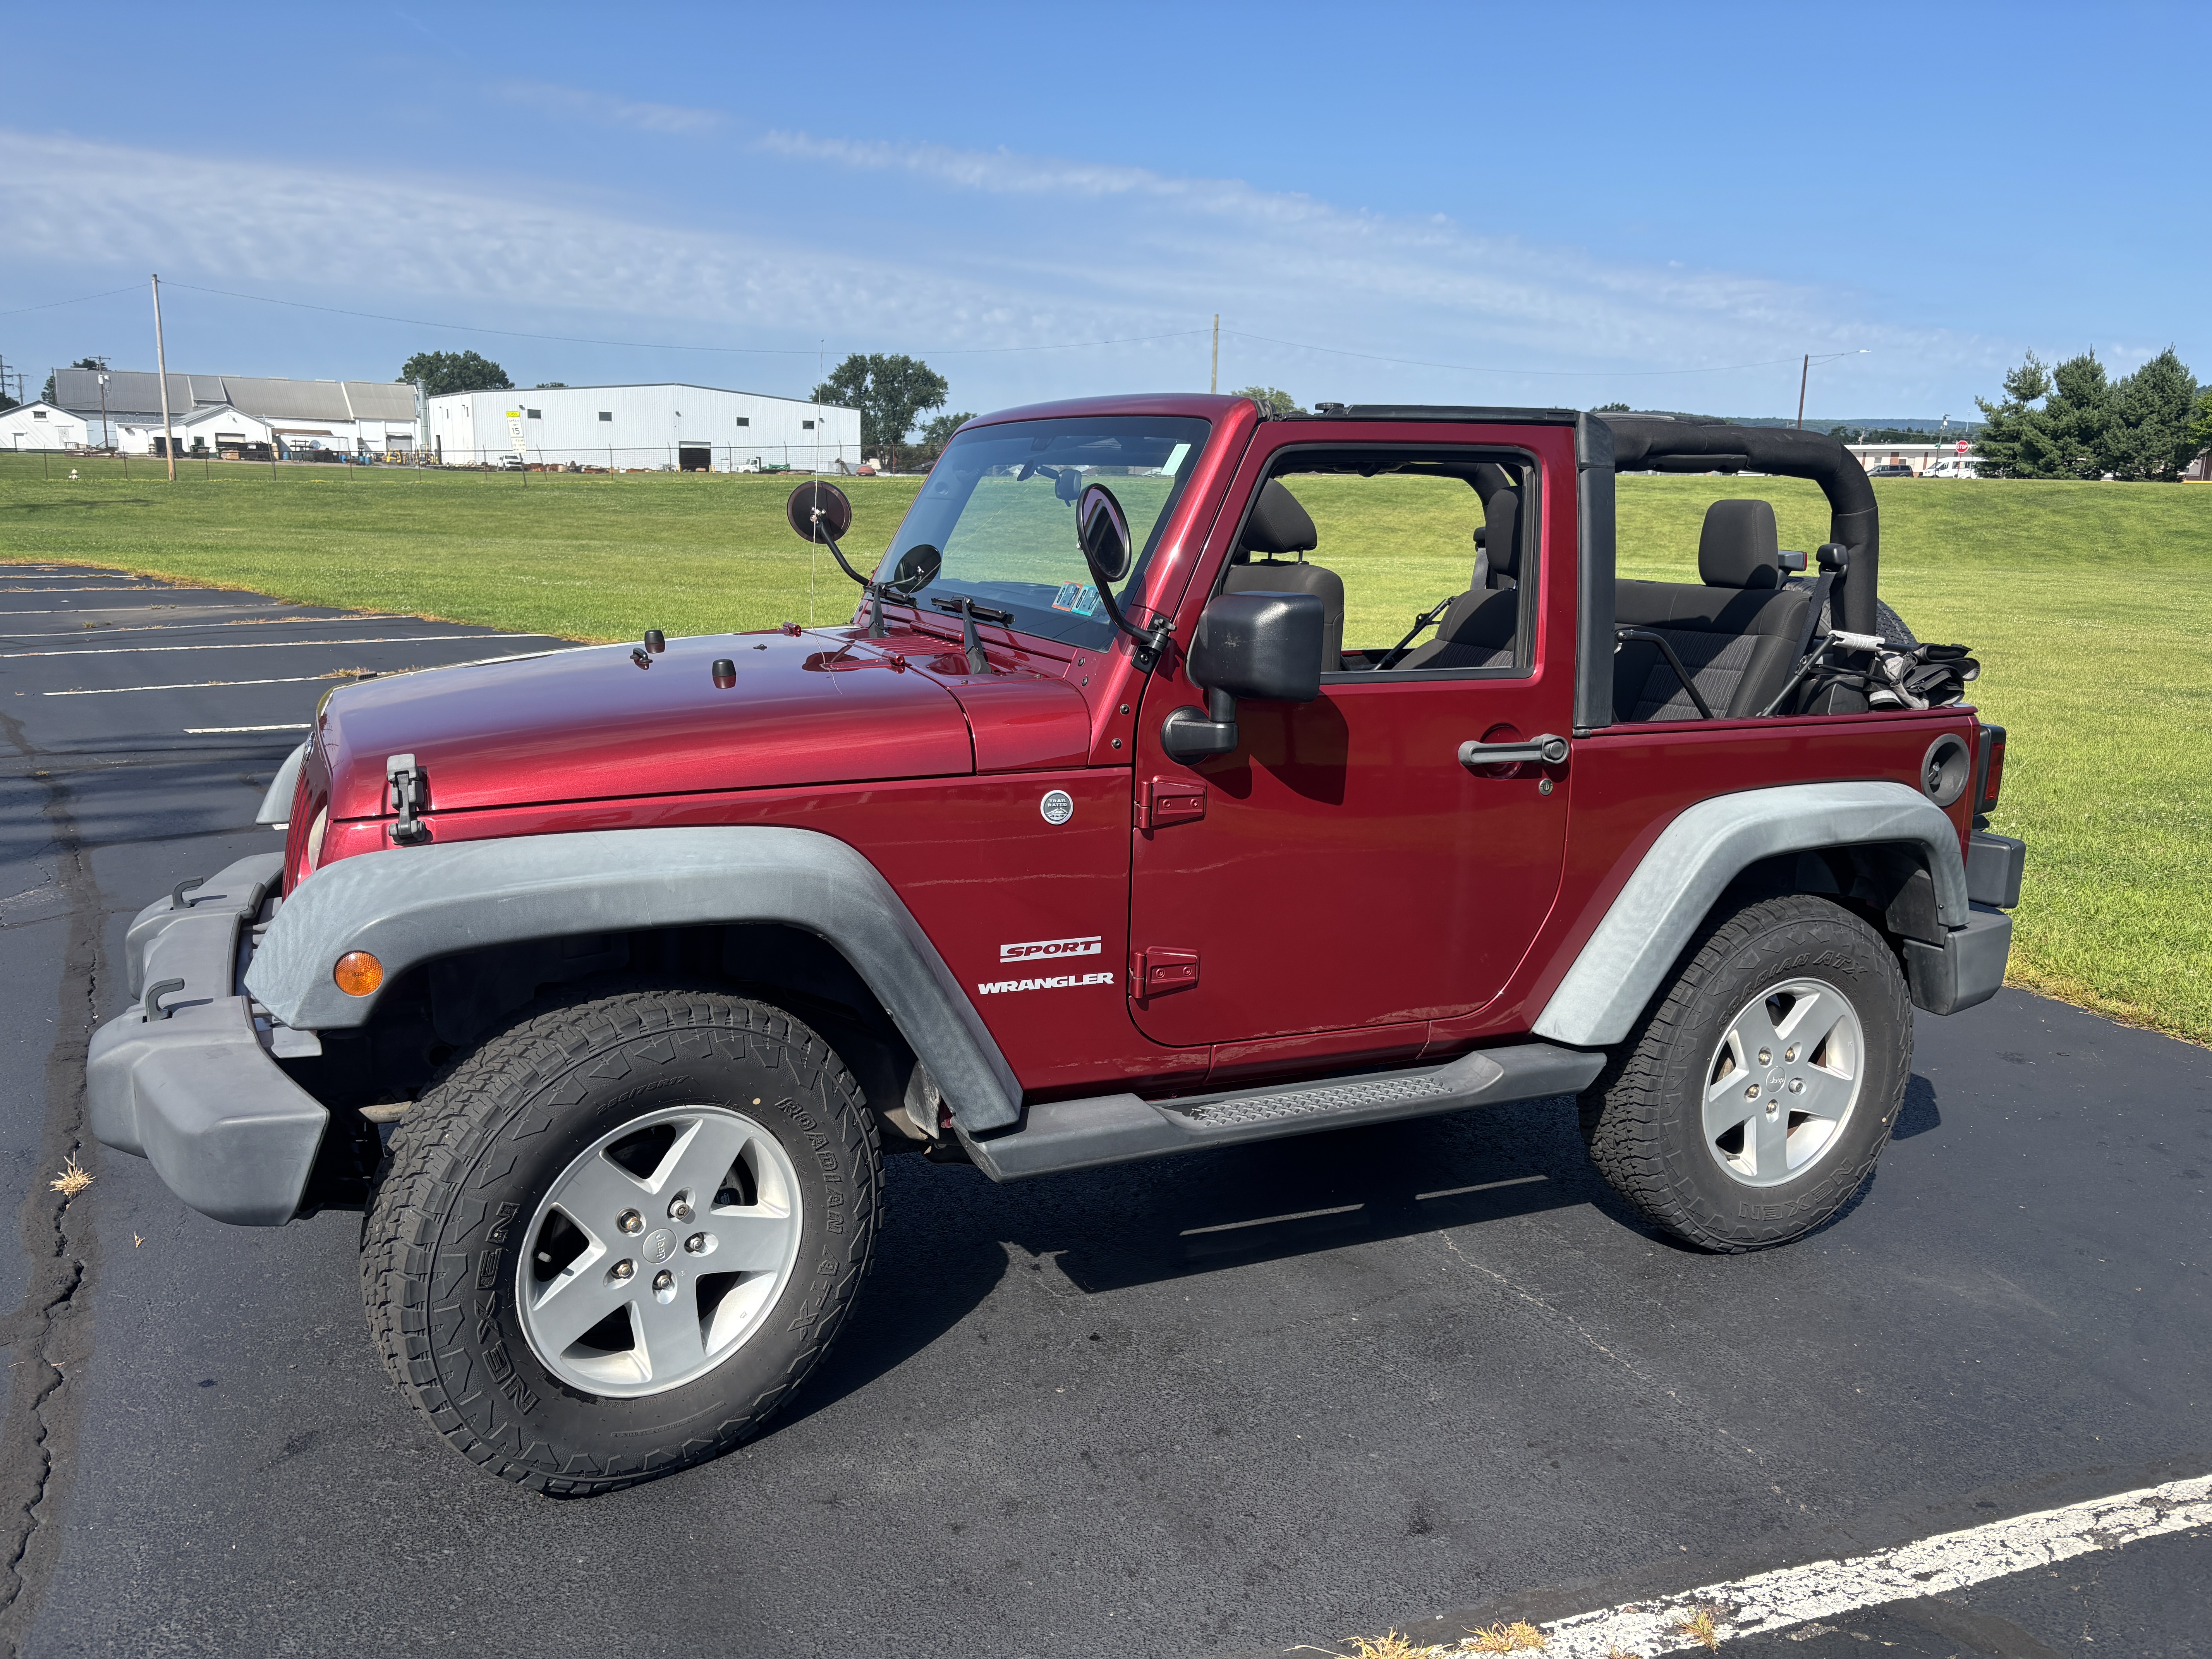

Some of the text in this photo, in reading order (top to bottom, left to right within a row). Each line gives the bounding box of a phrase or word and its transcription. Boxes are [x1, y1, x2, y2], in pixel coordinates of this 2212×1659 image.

[1076, 589, 1087, 609] 6
[1004, 939, 1101, 958] SPORT
[1812, 950, 1868, 982] ATX
[978, 972, 1115, 995] WRANGLER
[597, 1075, 690, 1116] 255/75R17
[1738, 1158, 1854, 1221] NEXEN
[775, 1097, 845, 1341] ROADIAN ATX
[655, 1233, 666, 1259] Jeep
[474, 1201, 541, 1415] NEXEN
